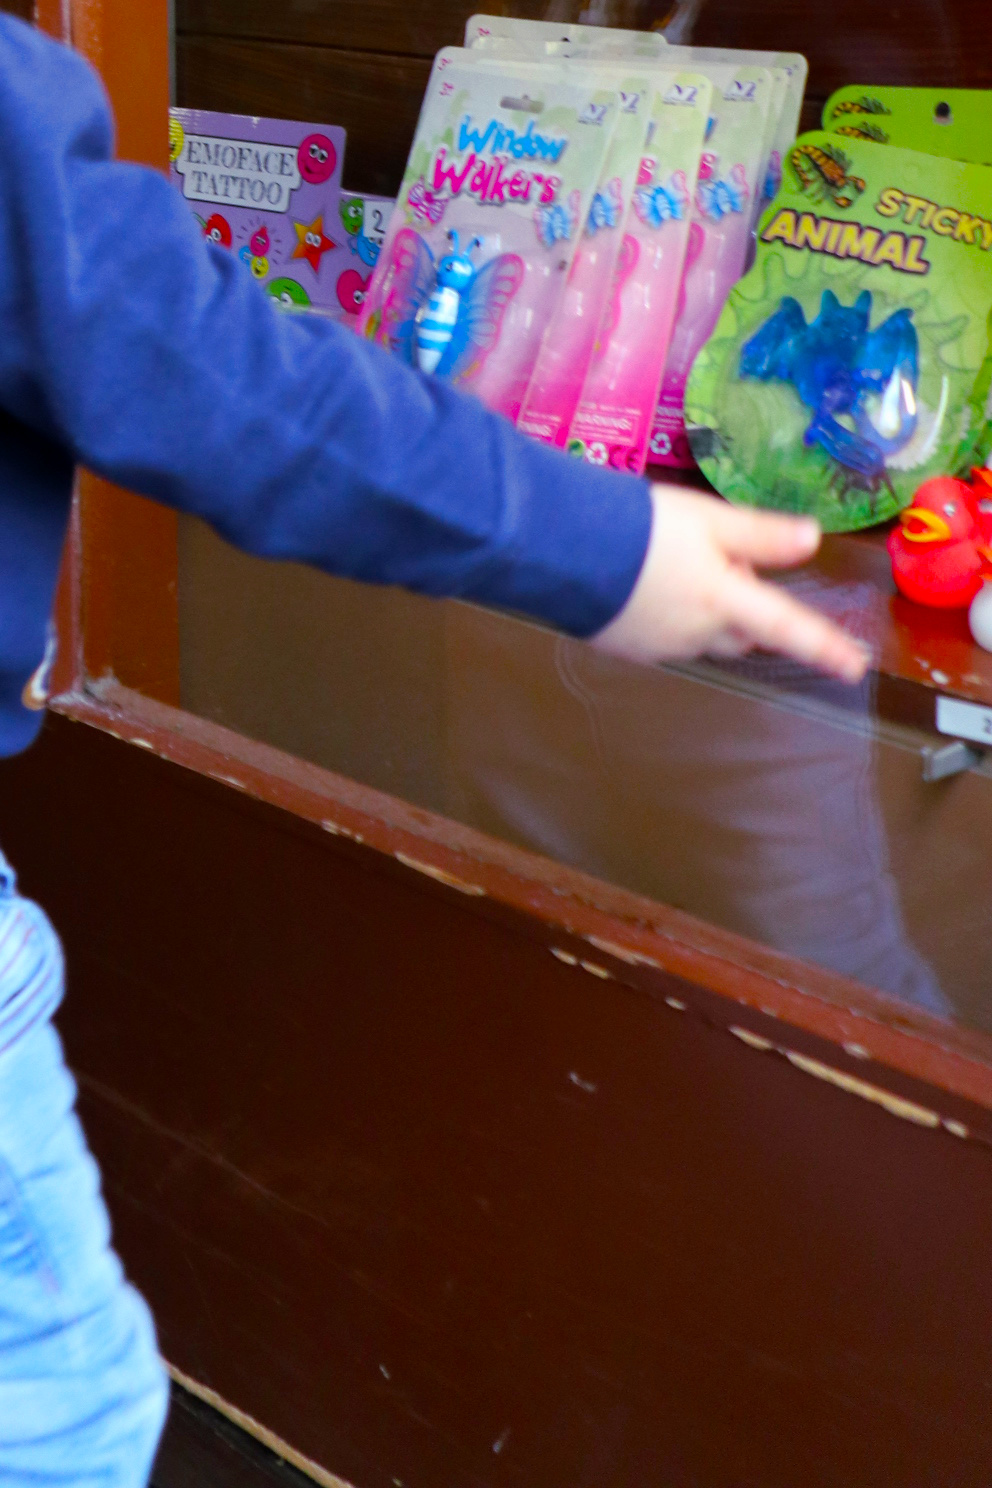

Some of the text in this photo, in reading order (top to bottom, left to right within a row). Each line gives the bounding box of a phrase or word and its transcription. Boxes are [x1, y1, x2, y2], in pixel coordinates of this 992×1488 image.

[186, 140, 295, 177] EMOFACE
[457, 114, 568, 164] Window
[193, 169, 283, 206] TATTOO
[432, 147, 562, 206] Walkers
[371, 208, 386, 235] 2
[761, 208, 930, 274] ANIMAL
[876, 187, 992, 251] STICKY
